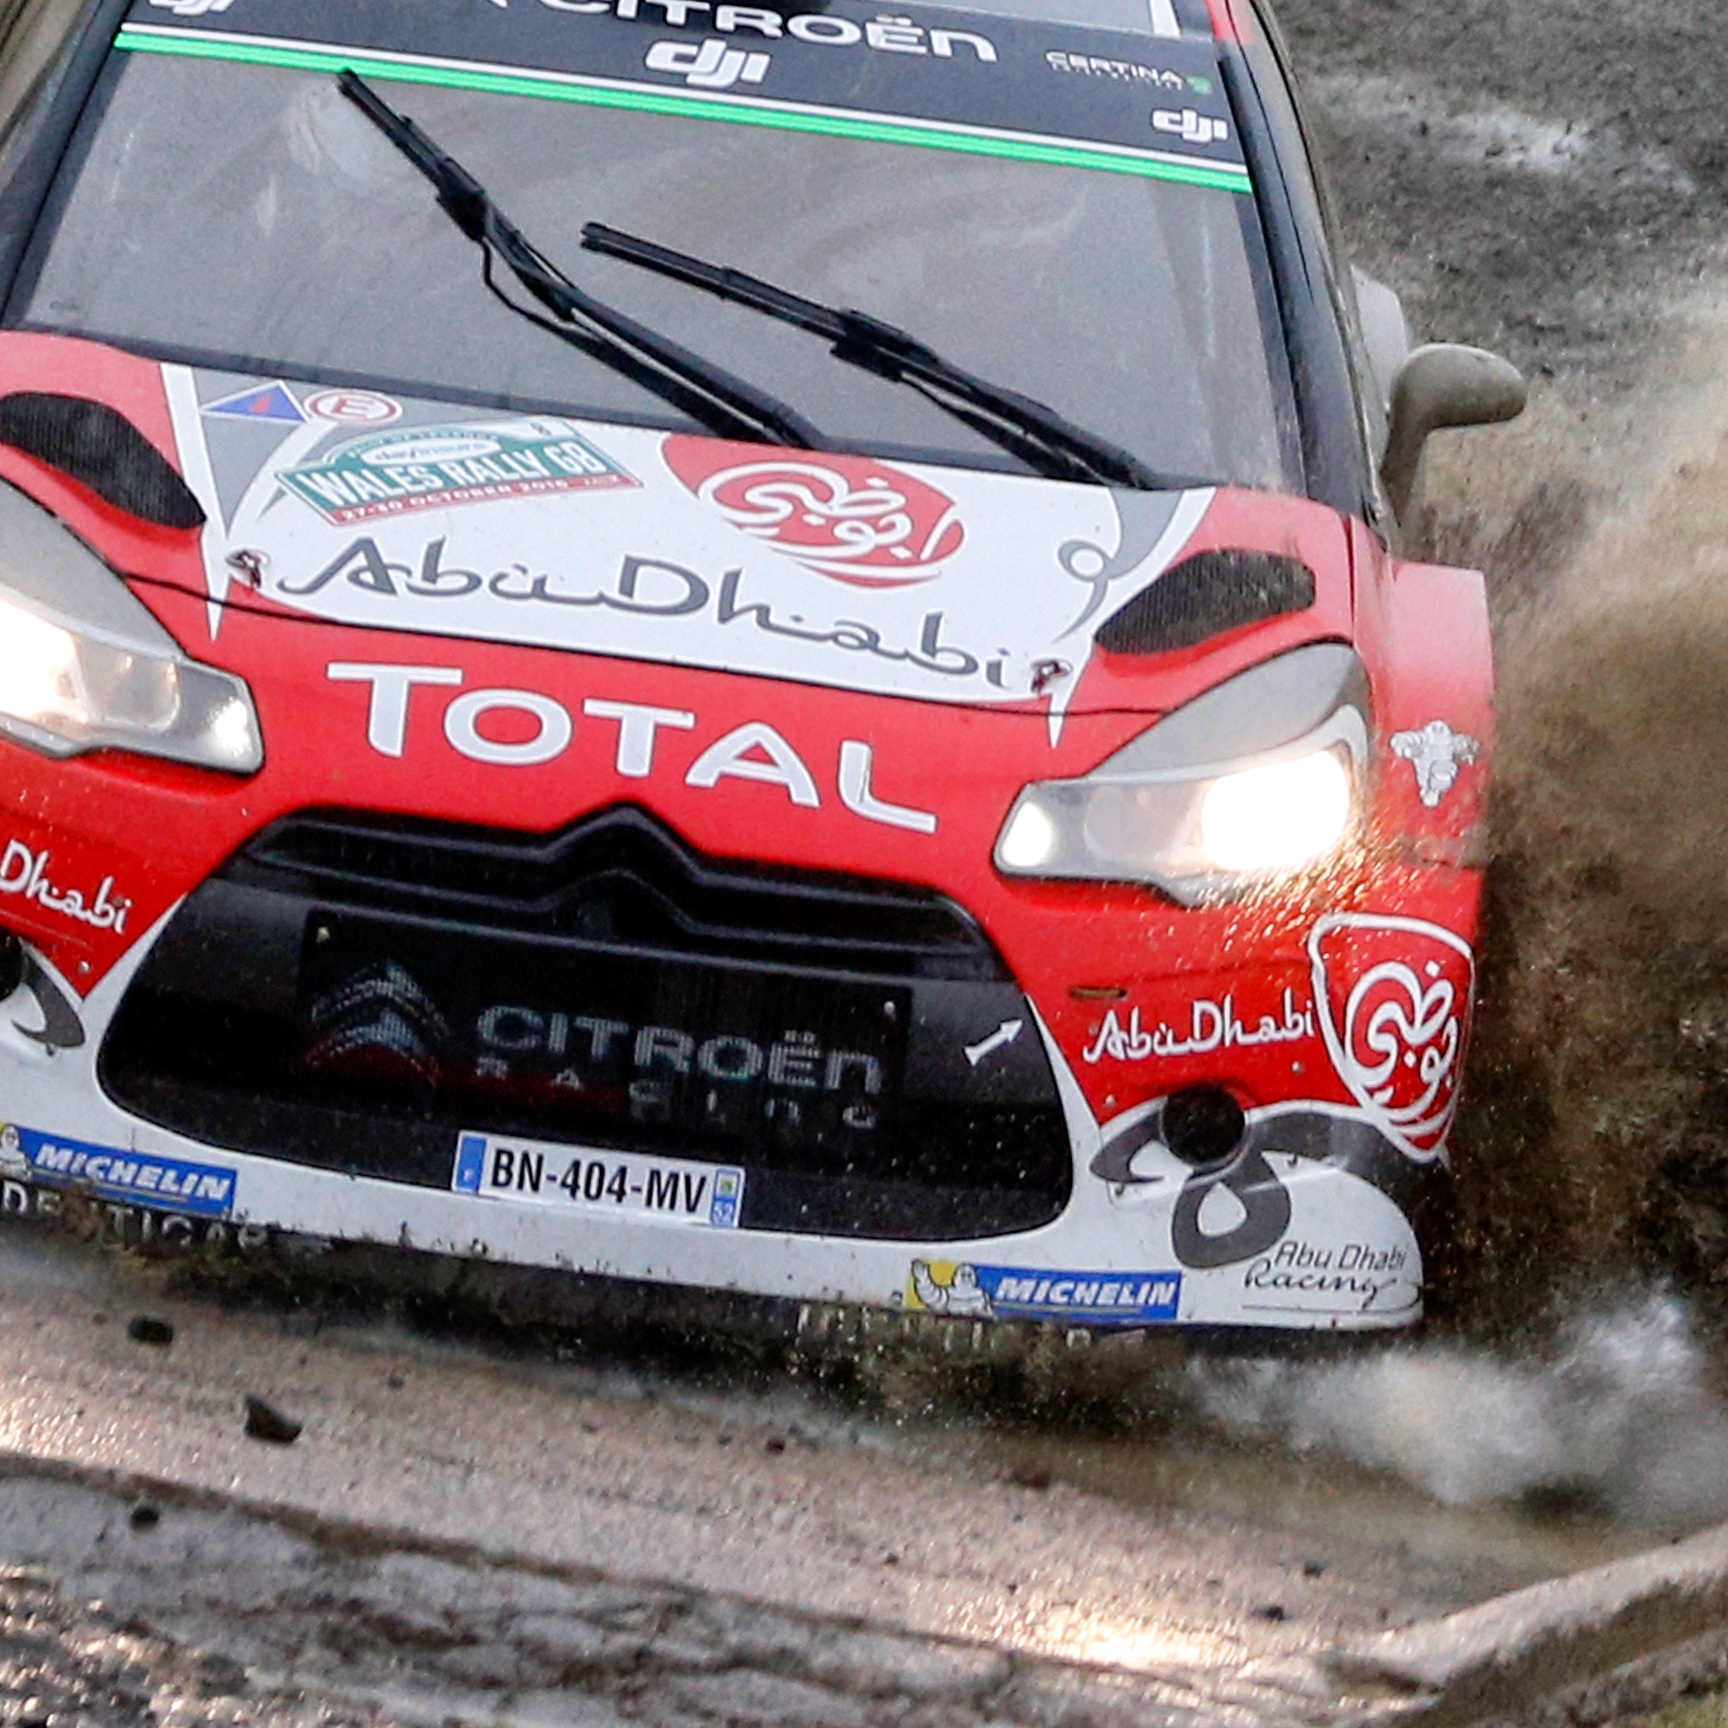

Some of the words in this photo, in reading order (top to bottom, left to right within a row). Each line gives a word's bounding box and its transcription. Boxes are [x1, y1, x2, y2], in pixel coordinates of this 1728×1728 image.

[644, 38, 773, 90] dji
[1045, 50, 1183, 88] CERTINA
[1151, 108, 1229, 144] dji
[297, 465, 444, 509] WALES
[447, 448, 548, 486] RALLY
[543, 441, 608, 475] GB
[409, 484, 512, 506] OCTOBER
[326, 661, 939, 835] TOTAL
[34, 1142, 231, 1202] MICHELIN
[491, 1148, 708, 1215] BN-404-MV
[1274, 1240, 1332, 1269] Abu
[1338, 1242, 1408, 1271] Dhabi
[994, 1276, 1176, 1307] MICHELIN
[1243, 1257, 1398, 1311] Racing
